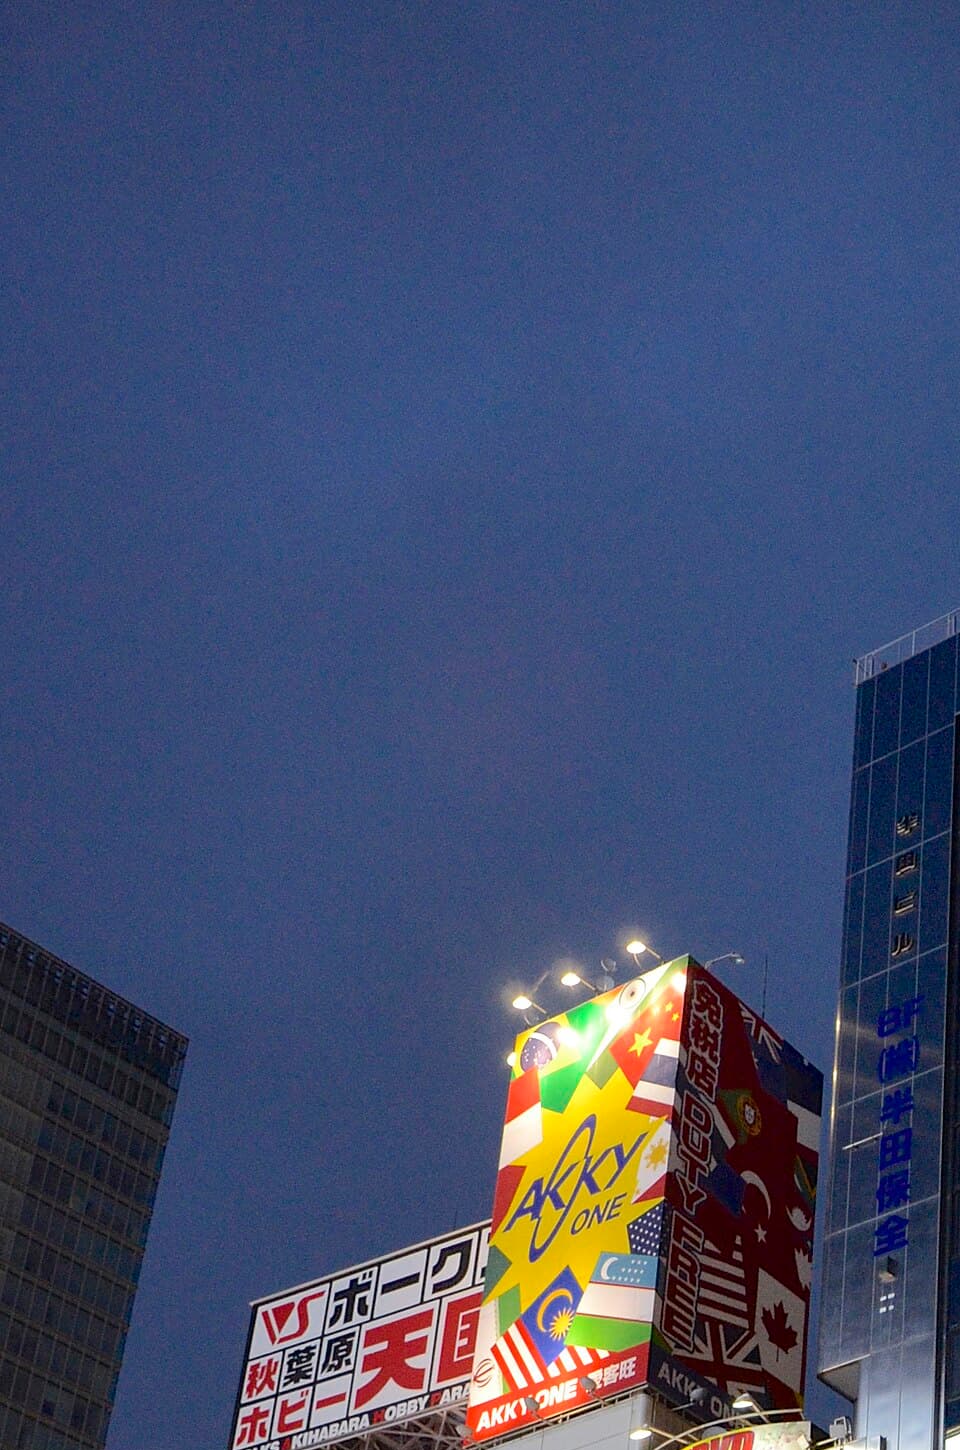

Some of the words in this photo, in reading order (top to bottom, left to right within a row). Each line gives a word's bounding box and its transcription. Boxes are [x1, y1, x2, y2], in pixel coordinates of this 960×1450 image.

[687, 980, 723, 1102] 免税店
[503, 1120, 648, 1248] AKKY
[676, 1091, 713, 1215] DUTY
[571, 1193, 628, 1236] ONE
[328, 1233, 489, 1328] ボーク
[661, 1211, 705, 1353] FREE
[246, 1333, 353, 1398] 秋葉原
[372, 1394, 430, 1425] HOBBY
[237, 1390, 347, 1446] ホビー
